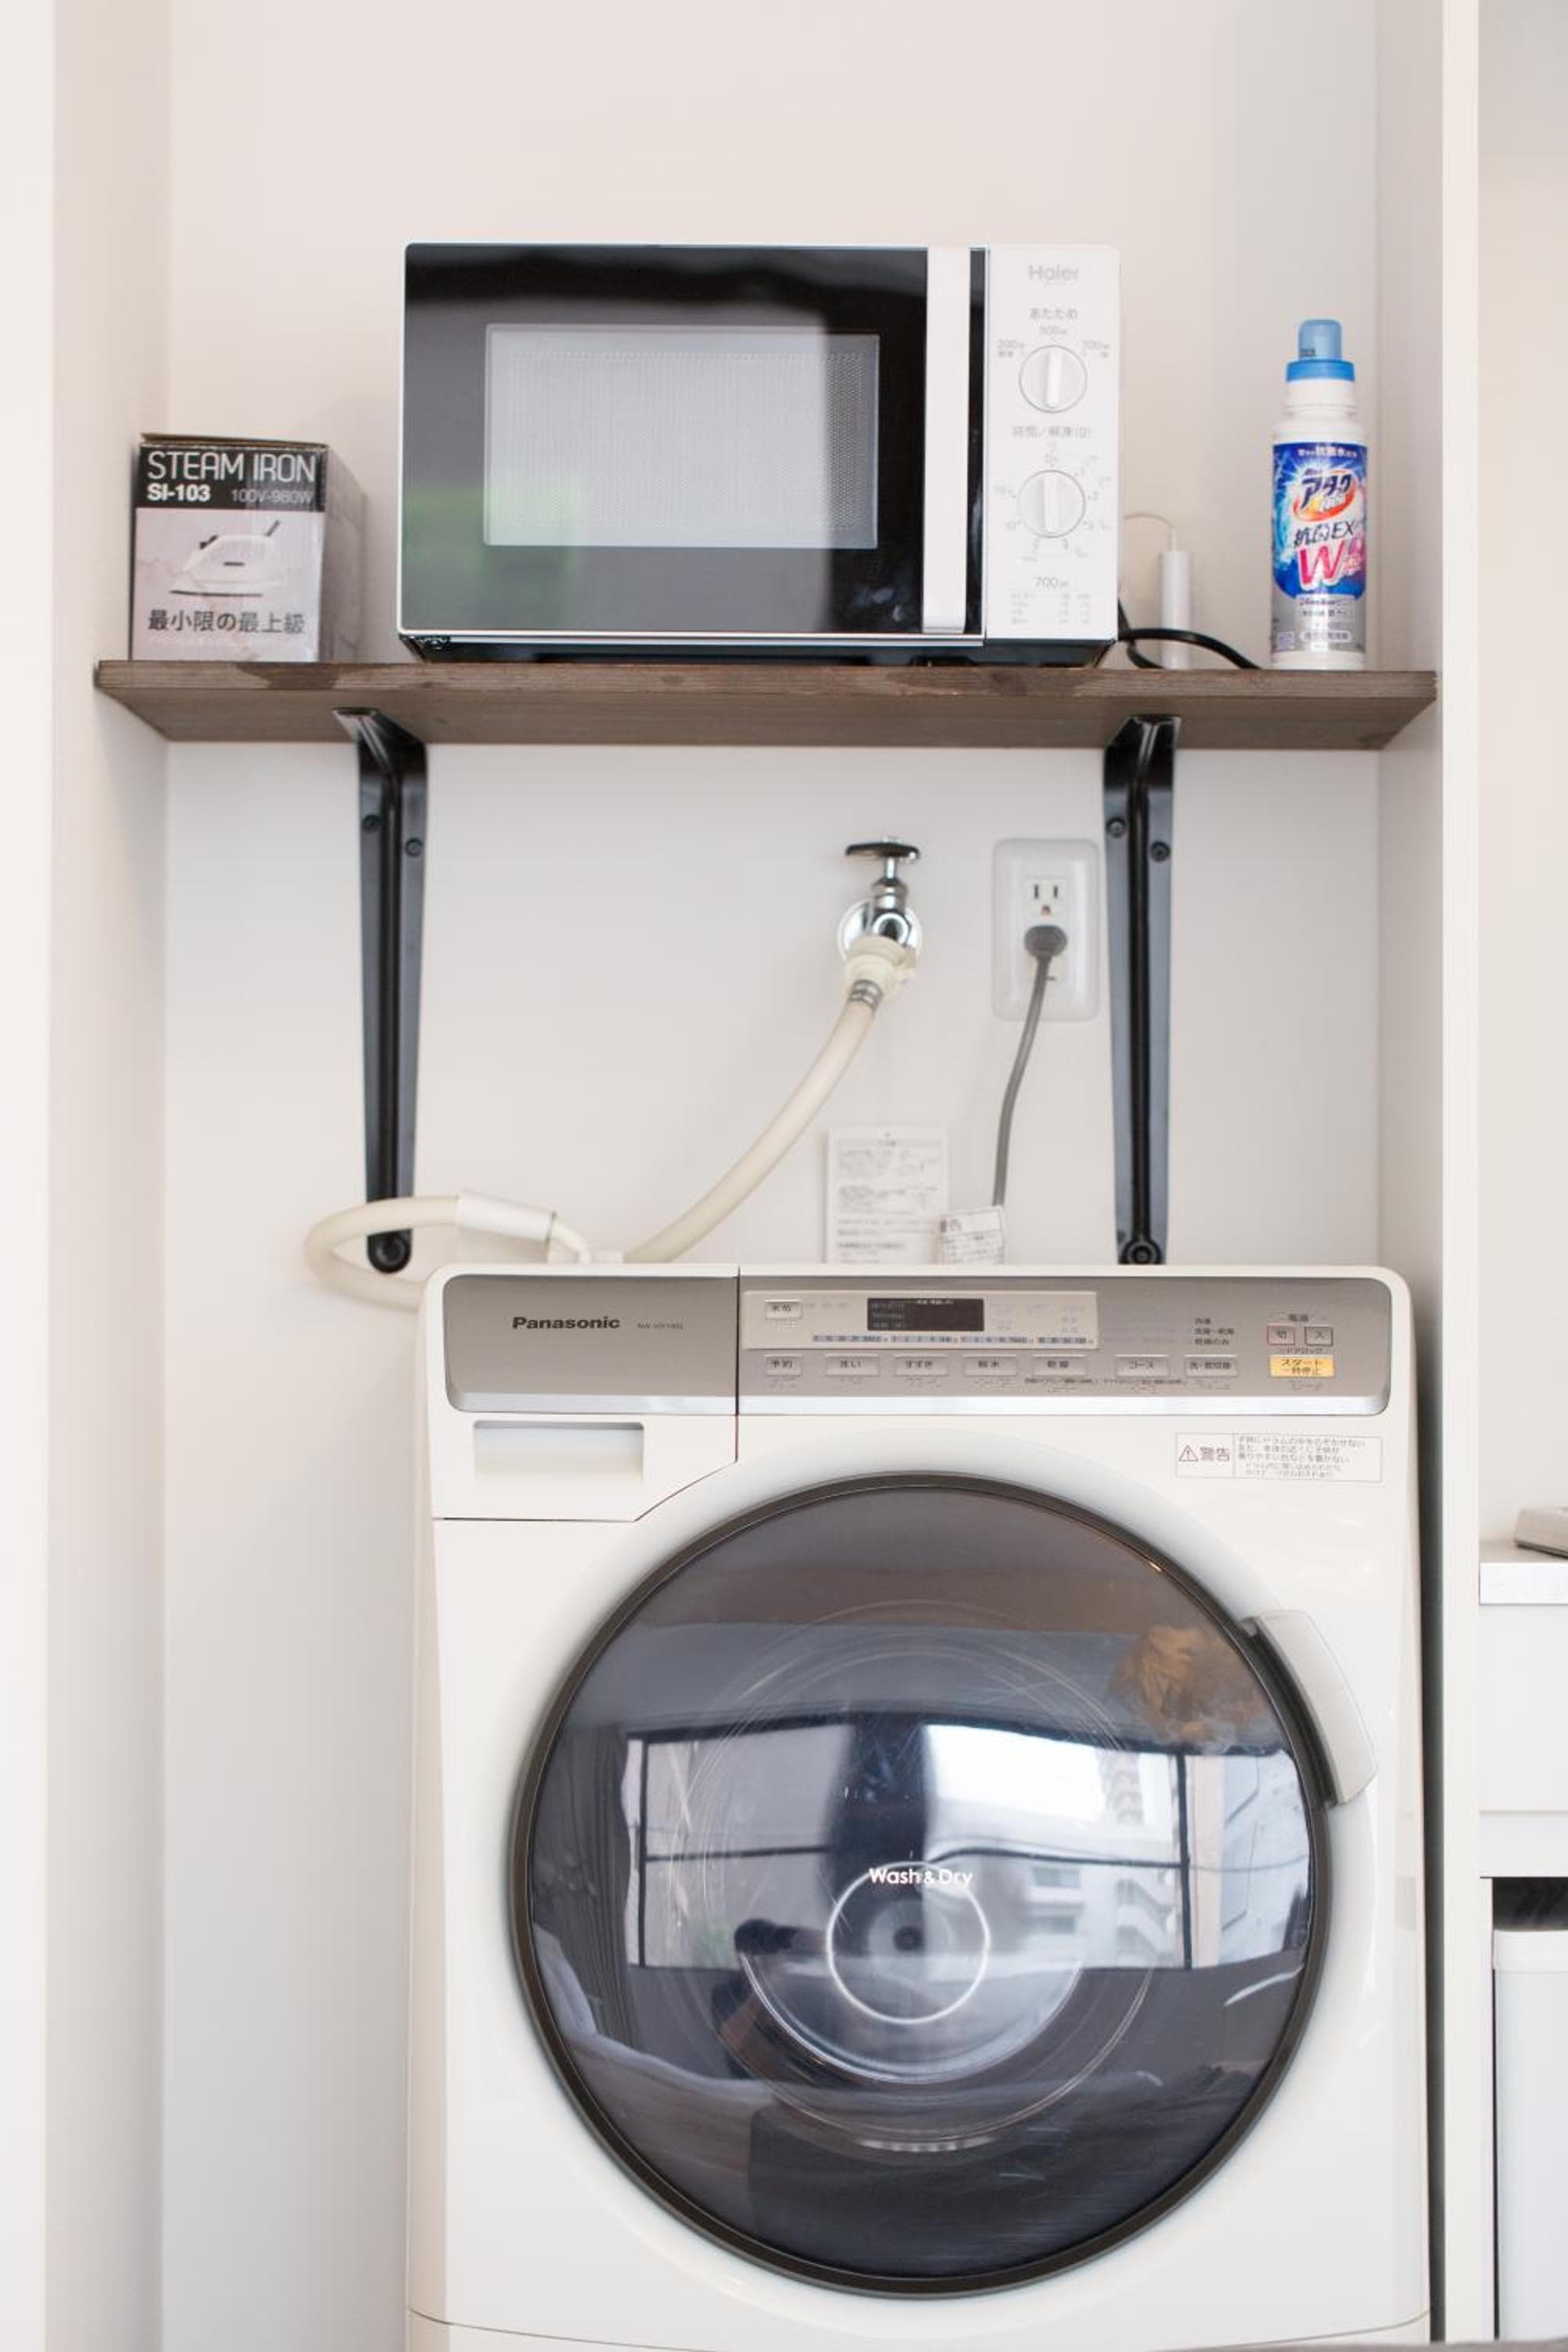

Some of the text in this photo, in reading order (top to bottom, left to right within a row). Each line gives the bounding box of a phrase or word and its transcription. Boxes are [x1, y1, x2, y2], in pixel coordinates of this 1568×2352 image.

[1028, 264, 1080, 281] Haier
[147, 451, 316, 483] STEAM IRON
[147, 484, 212, 502] SI-103
[148, 609, 307, 633] 最小限の最上級
[512, 1316, 621, 1330] Panasonic
